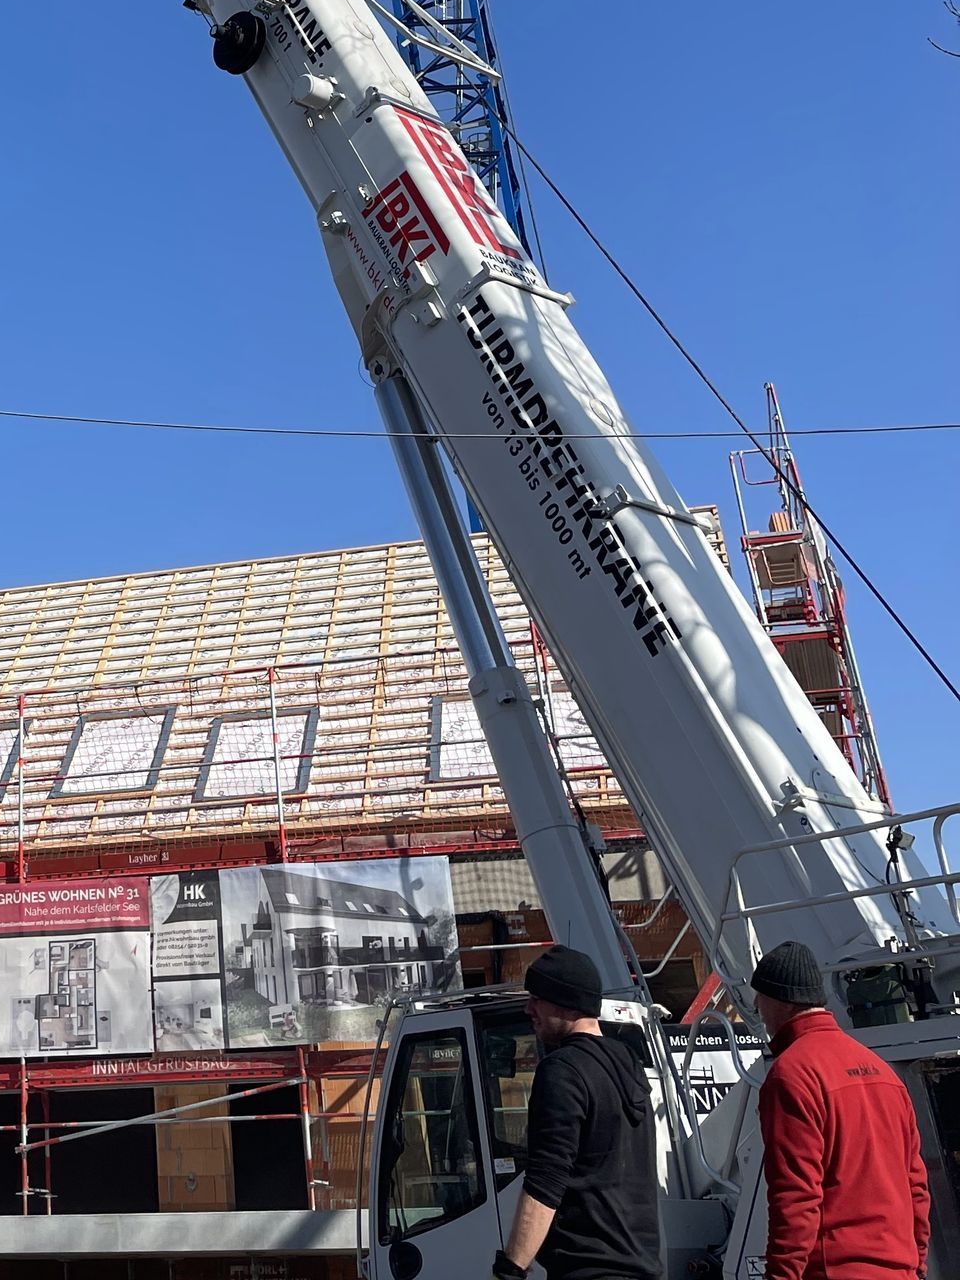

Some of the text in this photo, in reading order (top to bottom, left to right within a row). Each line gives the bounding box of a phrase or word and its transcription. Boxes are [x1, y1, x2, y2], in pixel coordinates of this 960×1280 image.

[270, 15, 288, 43] 700
[418, 125, 524, 261] BKL
[368, 220, 392, 261] BAUKRAN
[479, 249, 536, 277] BAUKRAN
[481, 391, 593, 581] von 13 bis 1000 mt
[128, 853, 158, 865] Layher
[48, 888, 106, 902] WOHNEN
[126, 889, 140, 900] 31
[183, 883, 207, 900] HK
[24, 901, 141, 917] Nahe dem Karlsfelder See
[669, 1035, 722, 1047] Müchen
